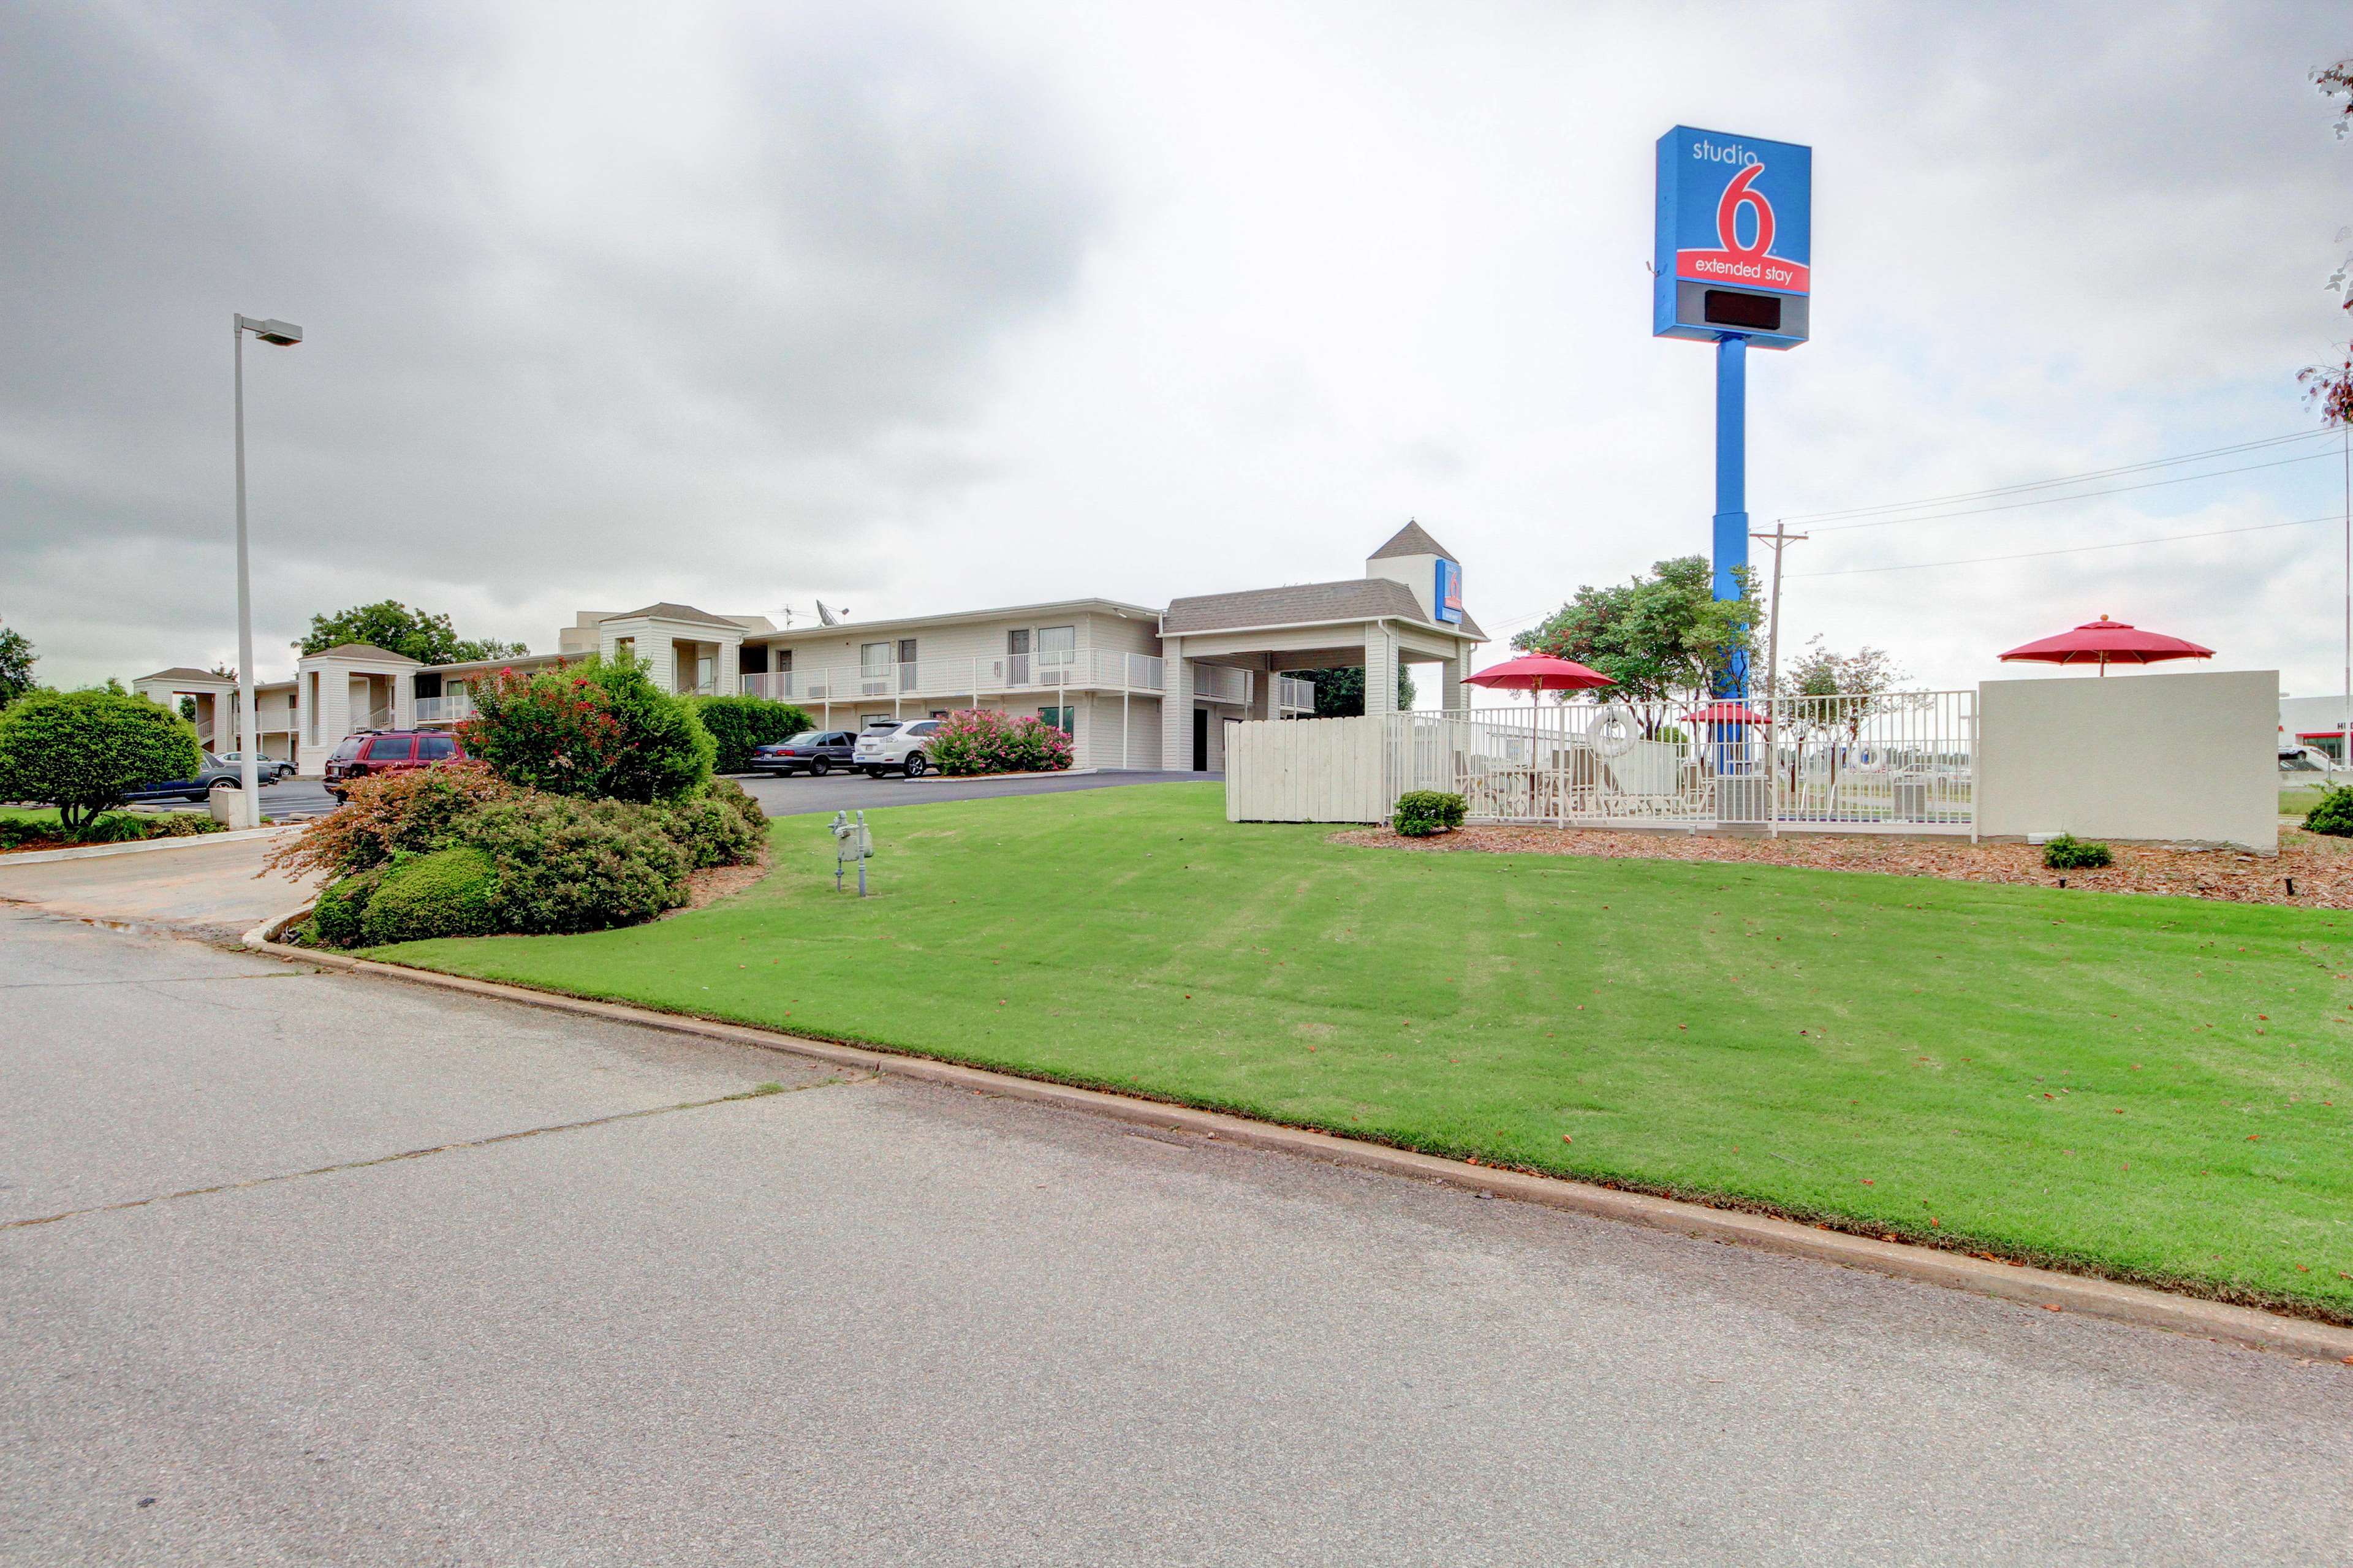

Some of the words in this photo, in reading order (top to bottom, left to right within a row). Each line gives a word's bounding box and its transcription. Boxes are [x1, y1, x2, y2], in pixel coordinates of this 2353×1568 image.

[1693, 140, 1757, 165] studio
[1716, 162, 1775, 256] 6
[1696, 259, 1760, 278] extended
[1765, 267, 1793, 286] stay
